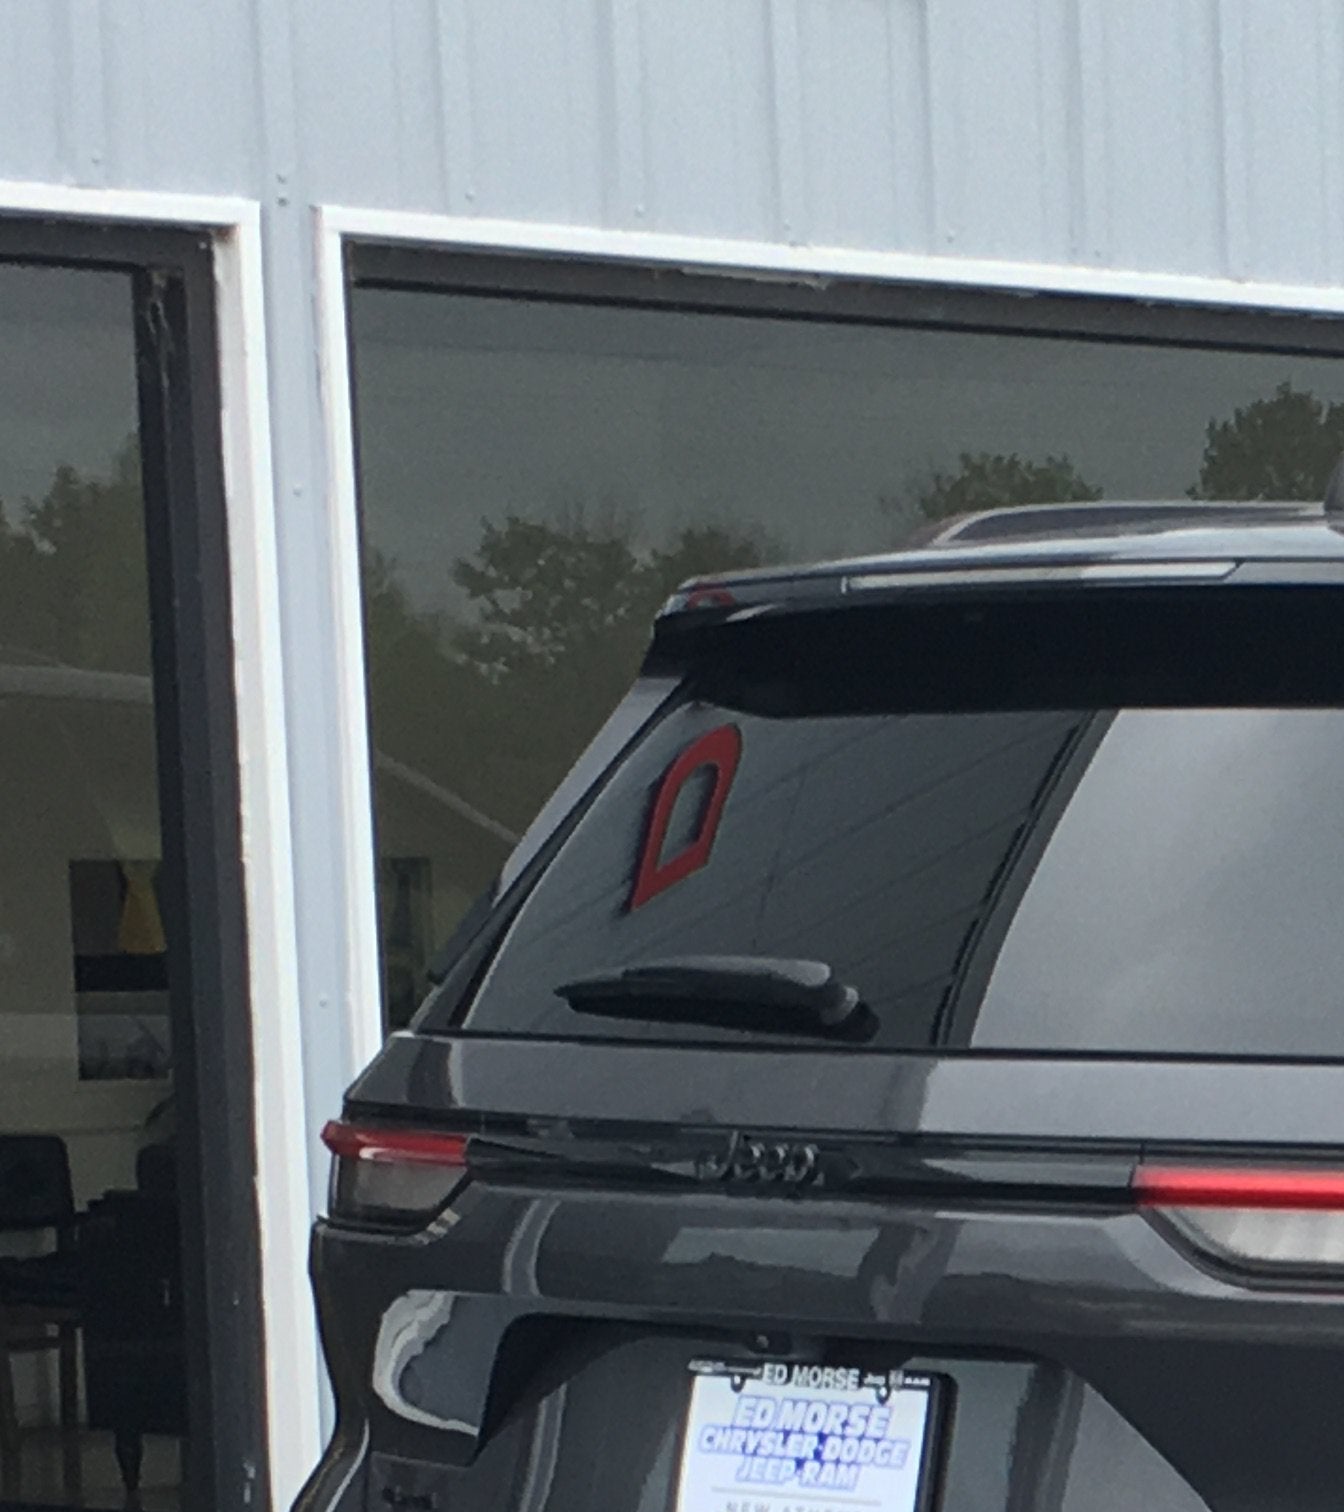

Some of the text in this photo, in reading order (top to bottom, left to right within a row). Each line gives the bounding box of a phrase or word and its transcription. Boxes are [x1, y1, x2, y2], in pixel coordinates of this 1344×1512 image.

[762, 1362, 788, 1384] ED
[792, 1365, 861, 1390] MORSE
[733, 1396, 893, 1438] ED MORSE
[736, 1457, 861, 1491] JEEP RAM
